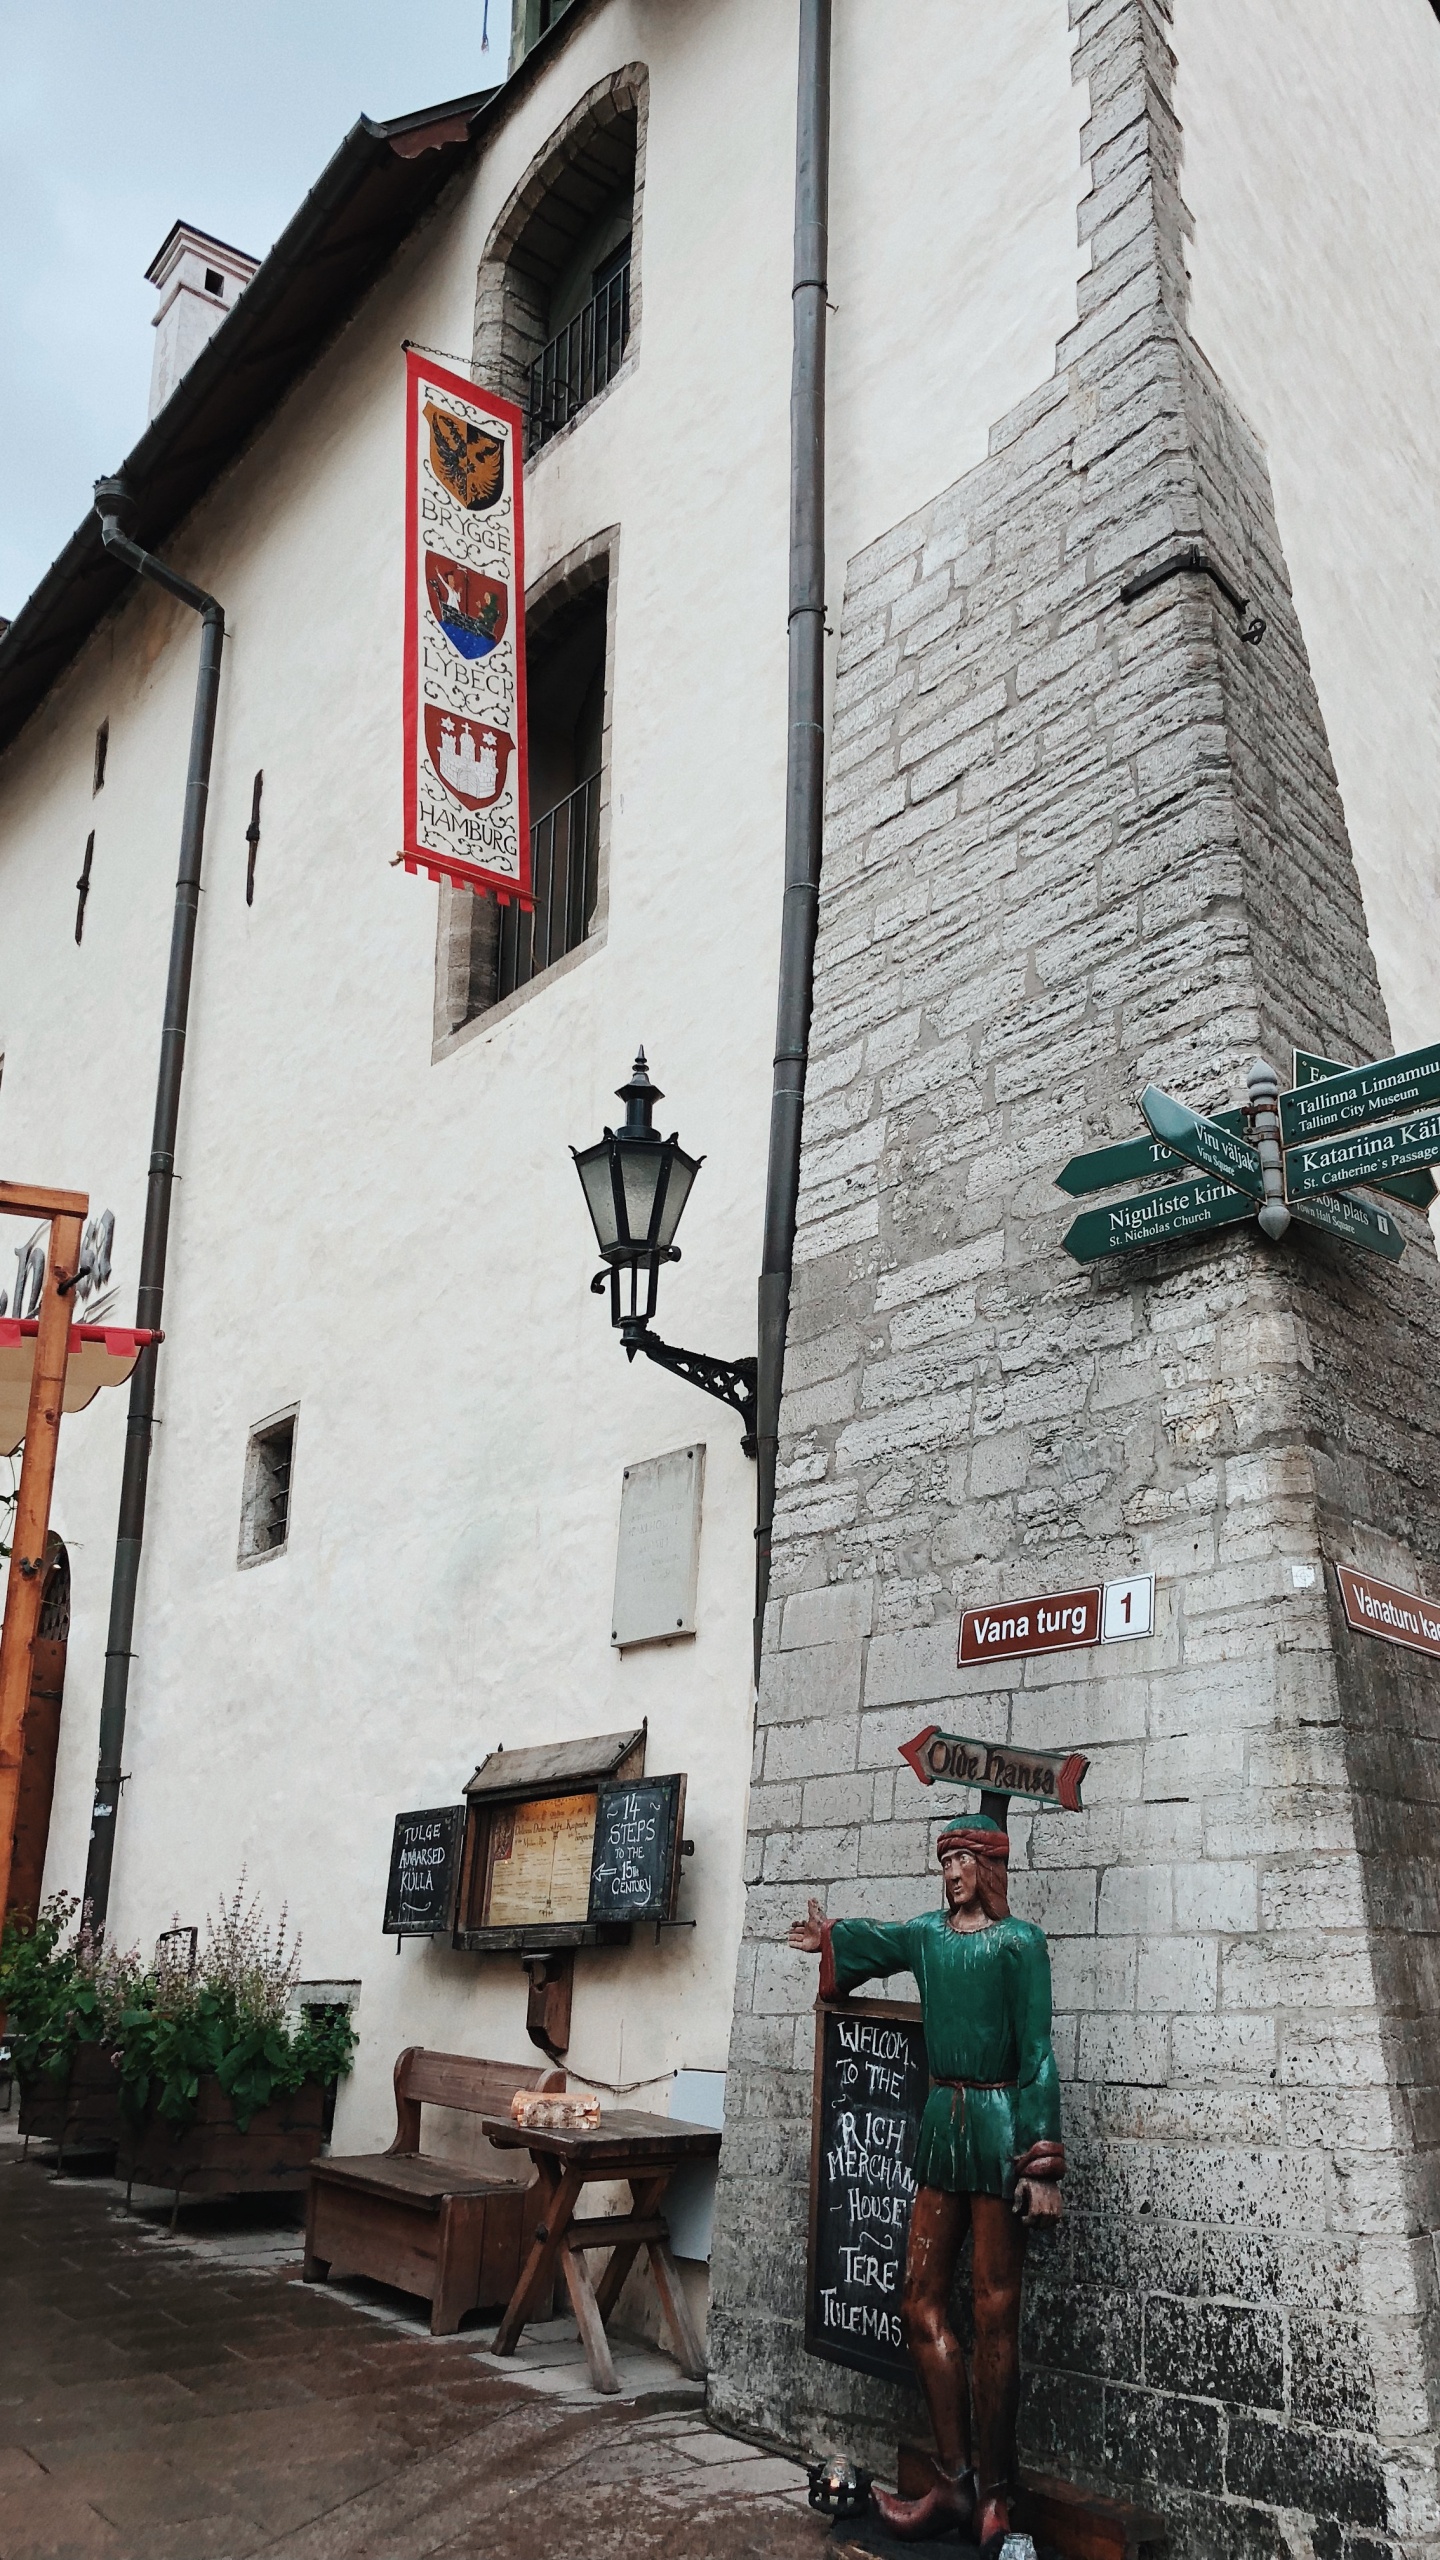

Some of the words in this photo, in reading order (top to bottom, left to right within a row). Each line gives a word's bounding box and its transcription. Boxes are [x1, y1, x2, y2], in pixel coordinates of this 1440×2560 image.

[422, 497, 511, 556] BRYGGE
[424, 646, 514, 703] LYBECK
[420, 800, 517, 856] HAMBURG
[1297, 1087, 1358, 1116] Tallinna
[1361, 1060, 1440, 1097] Linnamuu
[1298, 1112, 1338, 1132] Tallinn
[1341, 1104, 1365, 1119] City
[1368, 1087, 1419, 1111] Museum
[1194, 1121, 1219, 1151] Viru
[1221, 1142, 1254, 1173] väljak
[1212, 1154, 1235, 1176] Square
[1302, 1135, 1395, 1172] Katariina
[1303, 1178, 1319, 1190] St.
[1391, 1146, 1439, 1167] Passage
[1109, 1195, 1190, 1231] Niguliste
[1109, 1235, 1123, 1247] St.
[1125, 1221, 1170, 1242] Nicholas
[1173, 1209, 1211, 1228] Church
[1316, 1209, 1331, 1224] Hall
[1332, 1215, 1356, 1234] Square
[1343, 1201, 1369, 1226] plats
[974, 1615, 1029, 1644] Vana
[1036, 1606, 1087, 1635] turg
[1121, 1592, 1132, 1623] 1
[1353, 1584, 1419, 1634] Vanaturu
[928, 1740, 980, 1780] Olde
[622, 1792, 640, 1820] 14
[404, 1823, 441, 1845] TULGE
[607, 1818, 655, 1845] STEPS
[615, 1847, 624, 1859] TO
[627, 1846, 645, 1860] THE
[837, 2021, 915, 2068] WELCOM
[836, 2058, 858, 2085] TO
[865, 2061, 905, 2100] THE
[842, 2111, 906, 2153] RICH
[827, 2146, 918, 2203] MERCHAN
[848, 2188, 906, 2228] HOUSE
[838, 2245, 899, 2293] TERE
[820, 2286, 907, 2349] TULEMAS
